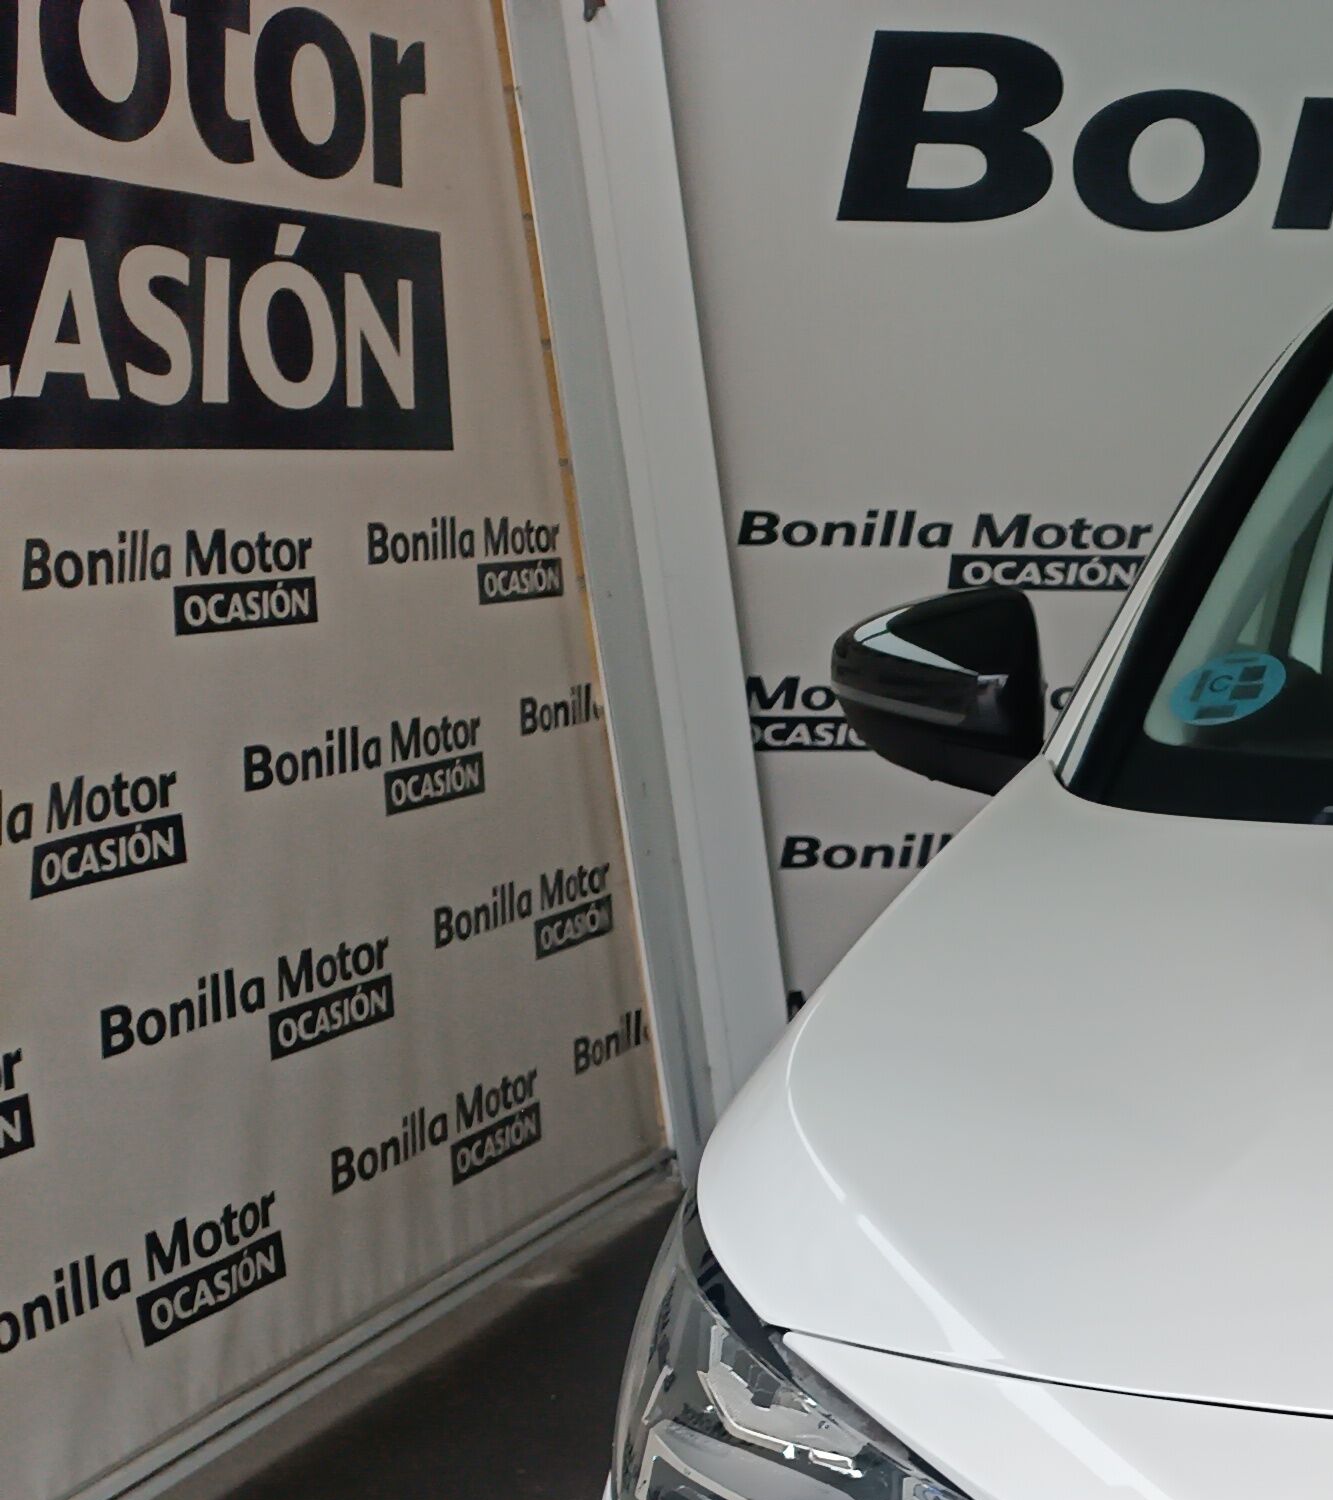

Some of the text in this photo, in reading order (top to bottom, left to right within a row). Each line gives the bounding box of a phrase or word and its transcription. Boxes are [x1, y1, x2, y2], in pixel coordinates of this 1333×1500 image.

[0, 0, 427, 188] otor
[0, 223, 415, 410] ASIÓN
[22, 527, 312, 591] Bonilla Motor
[366, 516, 560, 566] Bonilla Motor
[737, 510, 1153, 551] Bonilla Motor
[484, 560, 560, 599] OCASIÓN
[962, 555, 1138, 586] OCASIÓN
[183, 581, 311, 628] OCASIÓN
[243, 713, 483, 792] Bonilla Motor
[390, 756, 481, 806] OCASIÓN
[47, 770, 177, 834] Motor
[41, 824, 175, 886] OCASIÓN
[434, 880, 533, 949] Bonilla
[101, 935, 390, 1059] Bonilla Motor
[277, 981, 389, 1049] OCASIÓN
[331, 1067, 538, 1194] Bonilla Motor
[456, 1108, 537, 1173] OCASIÓN
[145, 1190, 275, 1282] Motor
[150, 1245, 276, 1330] OCASIÓN
